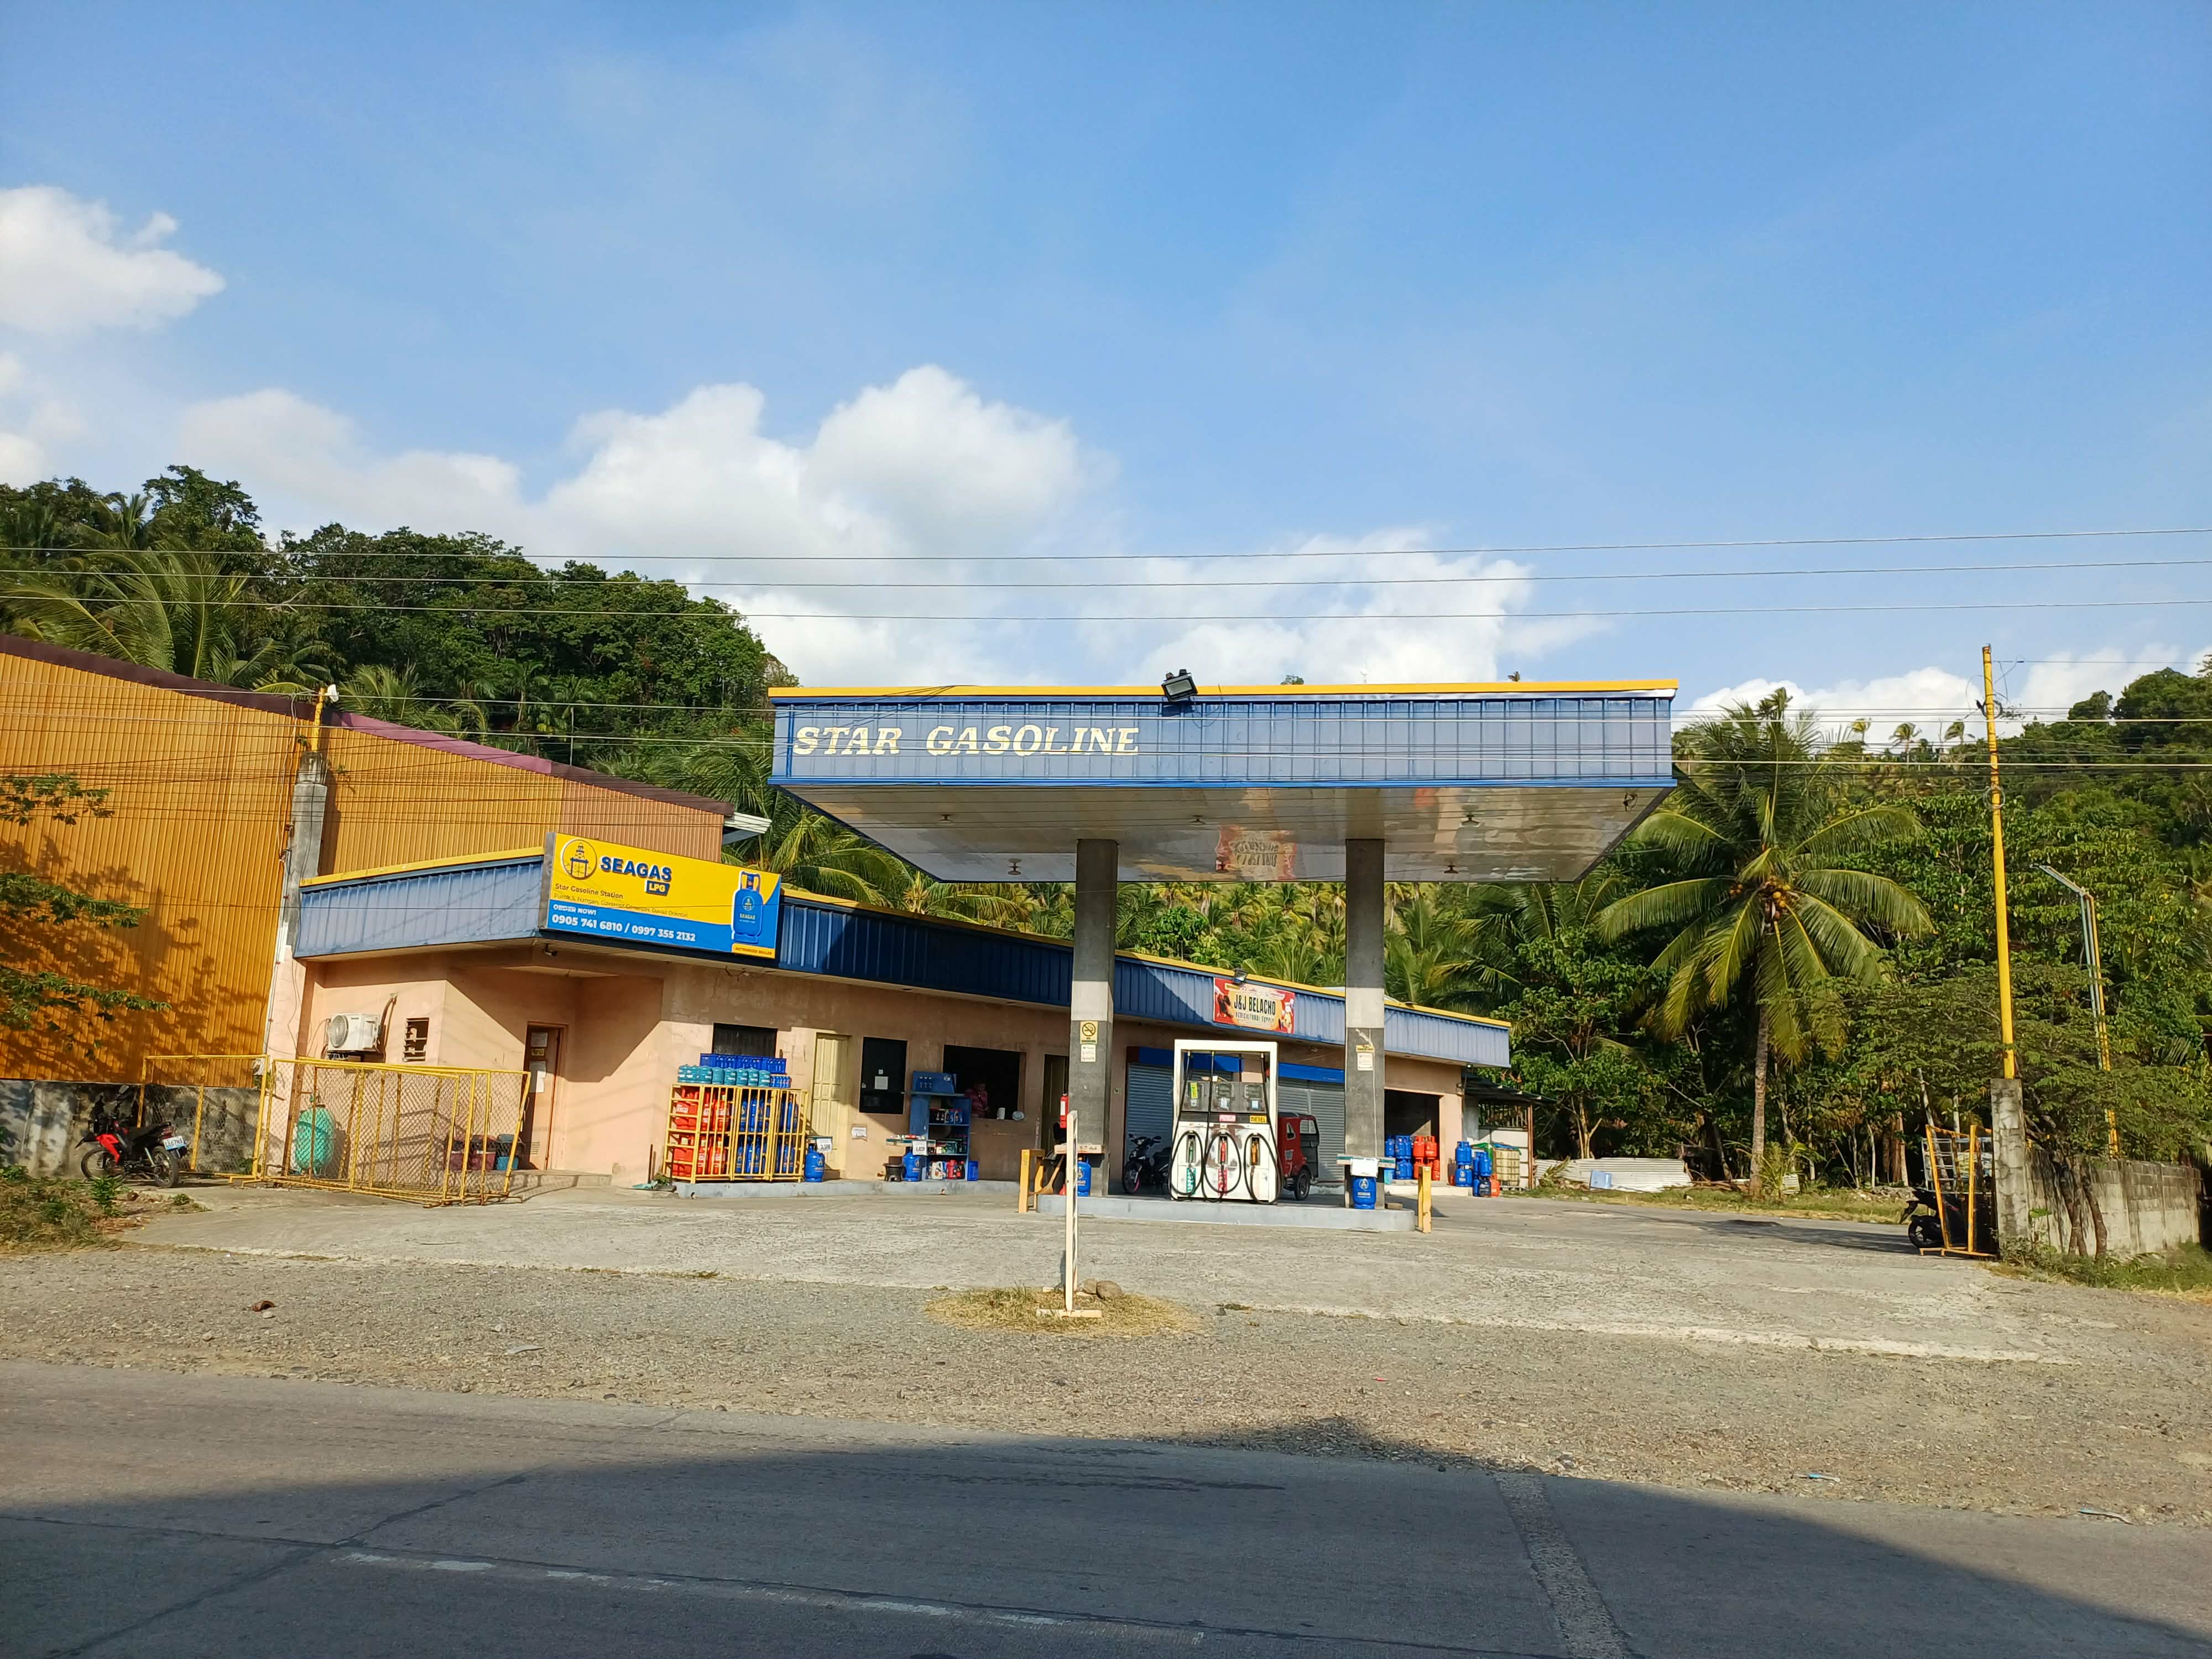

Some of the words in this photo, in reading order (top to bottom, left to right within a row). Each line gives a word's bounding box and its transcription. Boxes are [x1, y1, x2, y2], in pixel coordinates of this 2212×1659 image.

[793, 727, 902, 755] STAR
[926, 724, 1139, 757] GASOLINE
[601, 856, 672, 882] SEAGAS
[571, 886, 599, 895] Gasoline
[601, 890, 623, 899] Station
[649, 883, 666, 893] LPG
[553, 904, 576, 912] ORDER
[552, 914, 578, 926] 0905
[581, 917, 597, 928] 741
[599, 921, 623, 932] 6810
[632, 925, 656, 936] 0997
[658, 928, 674, 939] 355
[676, 931, 696, 942] 2132
[1234, 994, 1246, 1010] J&J
[1249, 997, 1276, 1016] BELACHO
